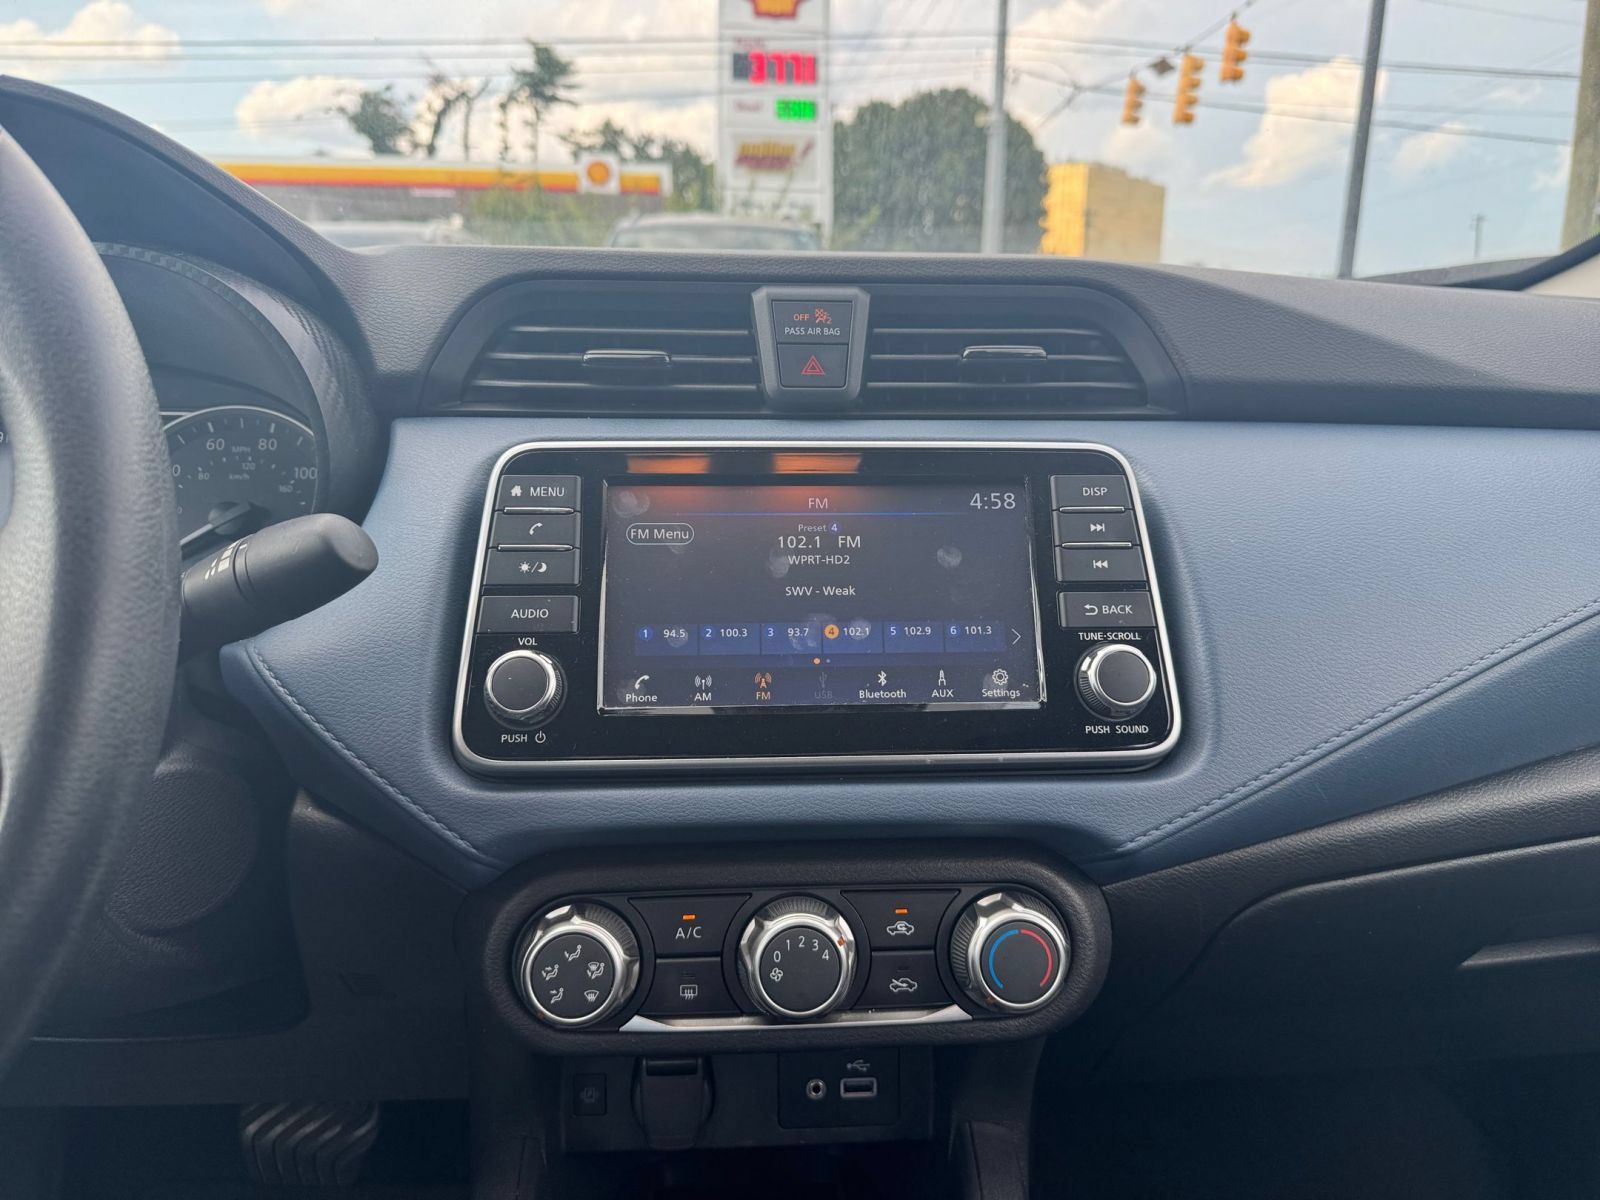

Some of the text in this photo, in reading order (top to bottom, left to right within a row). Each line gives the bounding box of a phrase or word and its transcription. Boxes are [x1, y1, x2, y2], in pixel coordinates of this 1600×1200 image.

[793, 313, 810, 321] OFF
[784, 327, 841, 336] PASS AIR BAG
[206, 438, 225, 451] 60
[258, 438, 278, 451] 80
[241, 462, 256, 471] 120
[294, 466, 318, 480] 100
[529, 486, 565, 497] MENU
[1082, 487, 1108, 497] DISP
[808, 497, 829, 510] FM
[969, 492, 1016, 511] 4:58
[798, 523, 839, 533] Preset 4
[630, 528, 690, 540] FM Menu
[777, 535, 861, 549] 102.1 FM
[788, 554, 851, 566] WPRT-HD2
[785, 586, 813, 597] SWV
[822, 585, 856, 597] Weak
[510, 608, 549, 619] AUDIO
[1102, 604, 1134, 615] BACK
[642, 628, 686, 639] 1 94.5
[705, 628, 748, 638] 2 100.3
[767, 627, 809, 637] 3 93.7
[827, 626, 870, 637] 4 102.1
[890, 625, 932, 636] 5 102.9
[950, 625, 993, 636] 6 101.3
[518, 637, 538, 646] VOL
[625, 692, 658, 703] Phone
[694, 692, 712, 702] AM
[755, 691, 771, 701] FM
[858, 688, 907, 699] Bluetooth
[931, 688, 954, 698] AUX
[981, 687, 1021, 700] Settings
[1085, 724, 1149, 734] PUSH SOUND
[501, 733, 528, 743] PUSH
[675, 926, 702, 940] A/C
[785, 939, 792, 951] 1
[798, 935, 806, 948] 2
[811, 939, 820, 952] 3
[773, 950, 782, 963] 0
[821, 949, 830, 961] 4
